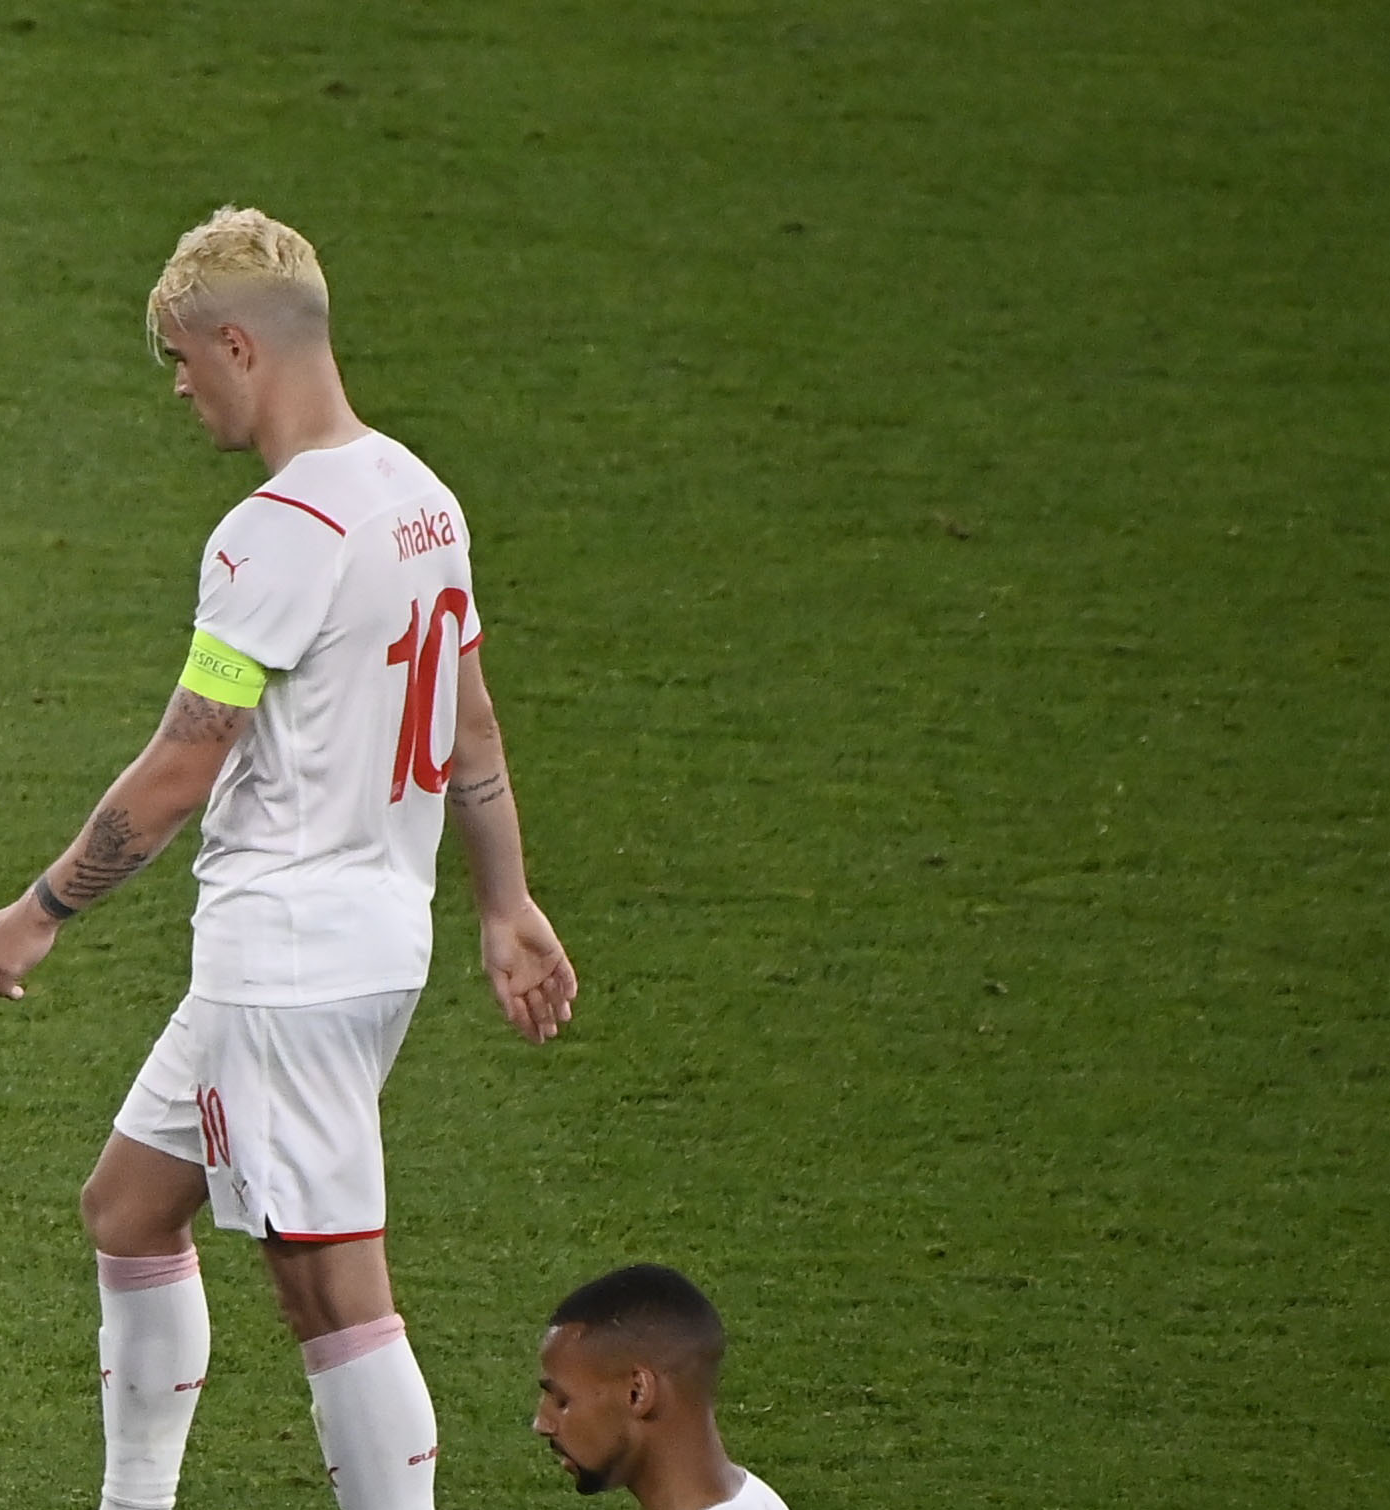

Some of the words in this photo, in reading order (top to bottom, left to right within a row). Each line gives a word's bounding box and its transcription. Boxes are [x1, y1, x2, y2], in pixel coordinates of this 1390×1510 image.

[392, 507, 457, 563] xhaka
[386, 586, 469, 805] 10
[196, 1083, 231, 1168] 10
